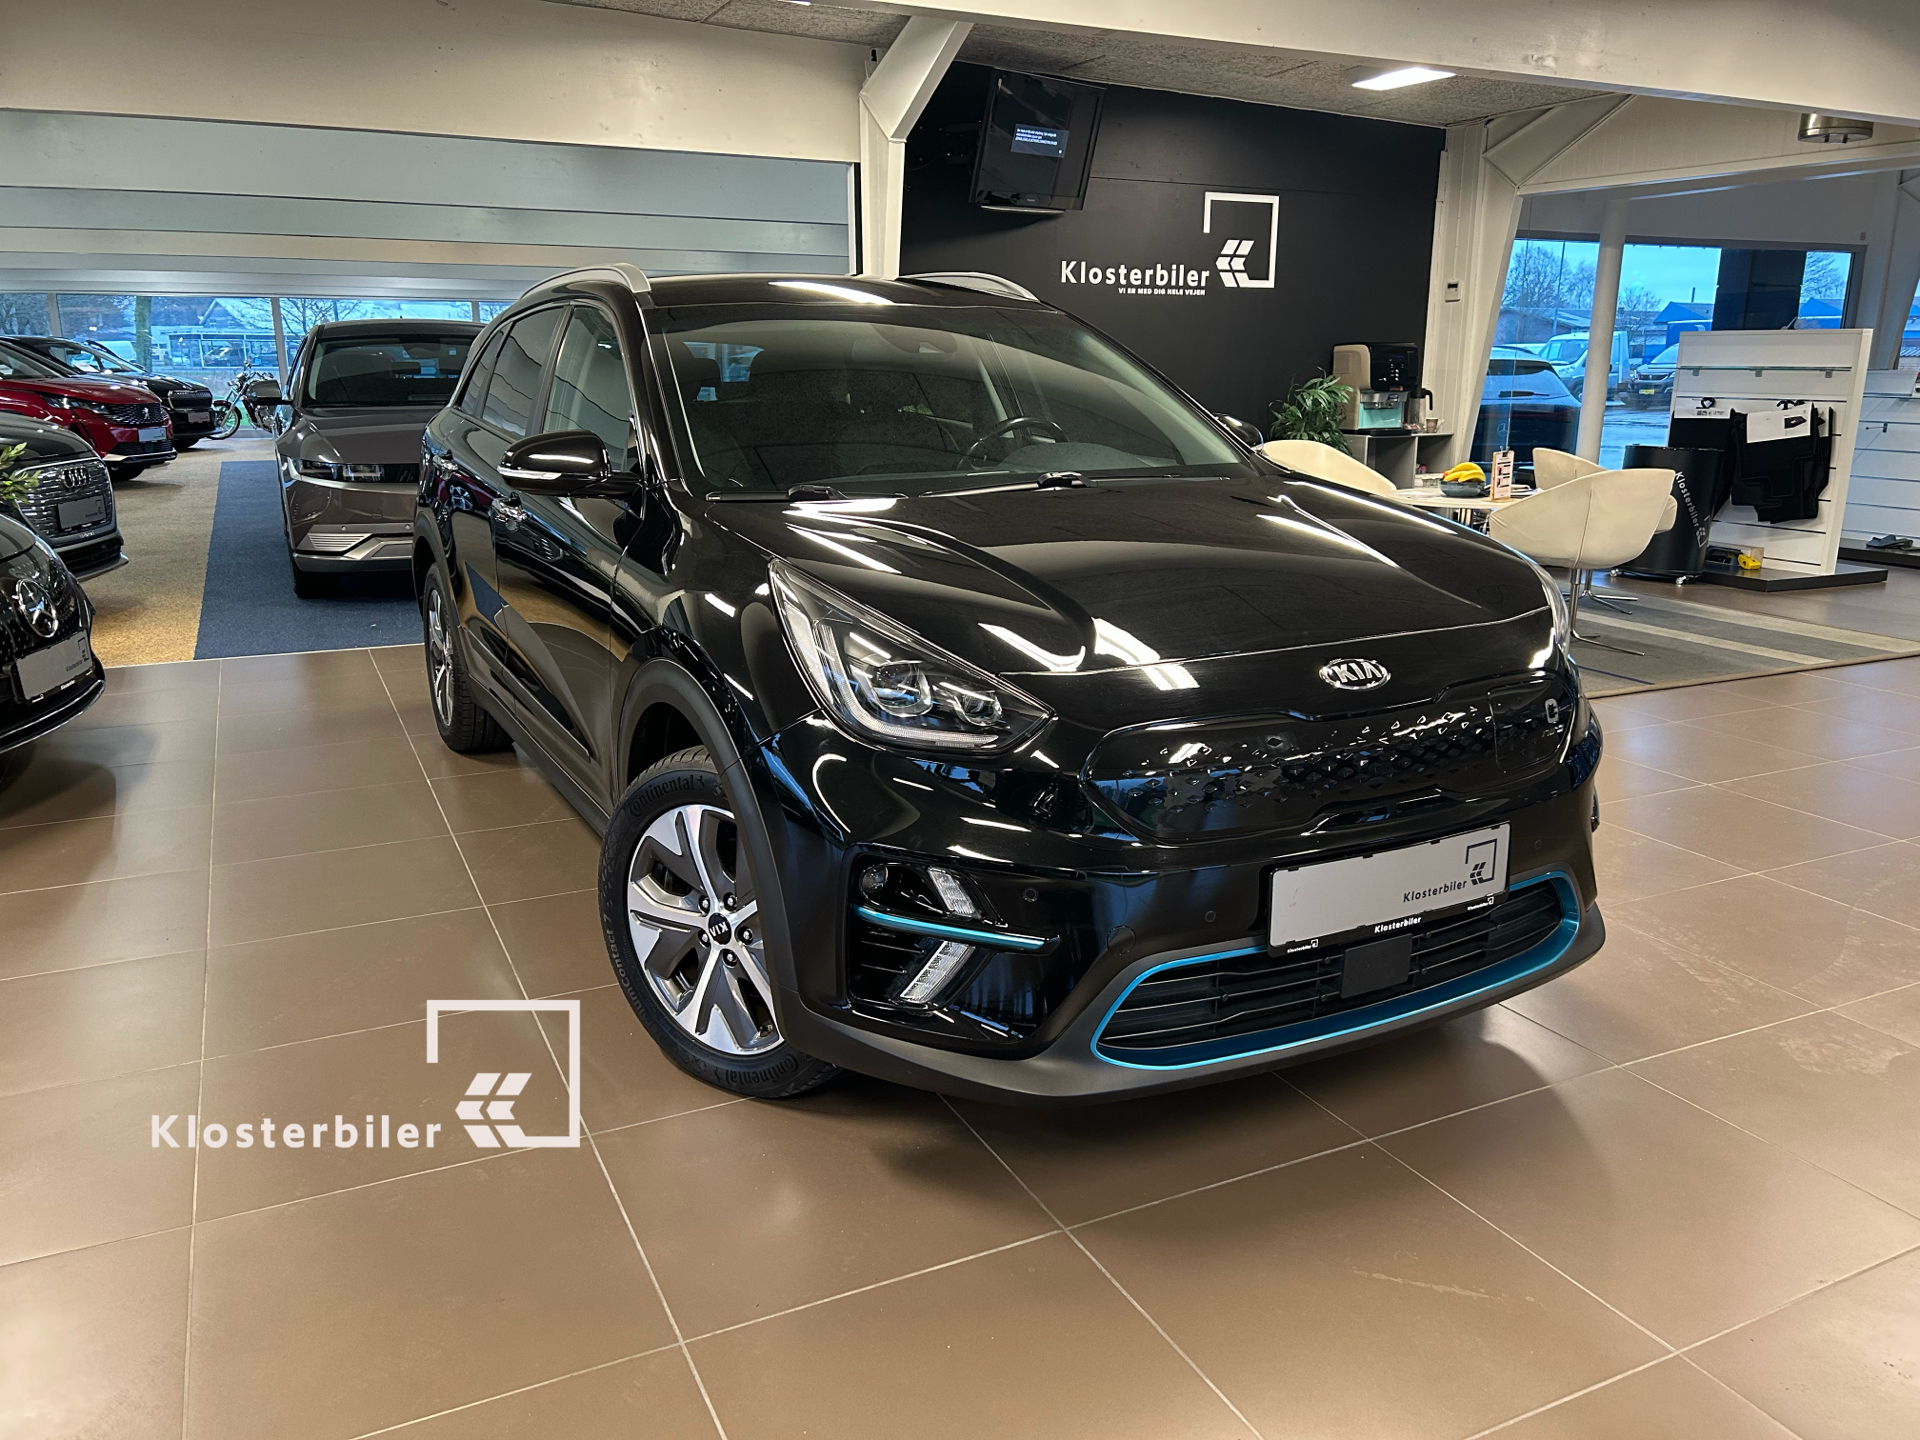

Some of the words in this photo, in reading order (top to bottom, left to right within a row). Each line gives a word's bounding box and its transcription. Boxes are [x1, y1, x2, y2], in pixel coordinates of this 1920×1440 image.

[1061, 260, 1210, 287] Klosterbiler
[1675, 471, 1699, 527] Klosterbiler
[1329, 660, 1383, 684] KIA
[629, 774, 695, 817] Continental
[1403, 880, 1467, 903] Klosterbiler
[709, 921, 729, 937] KIA
[1374, 917, 1422, 933] Klosterbiler
[606, 928, 660, 1036] emiumContact
[725, 1053, 800, 1086] Continental
